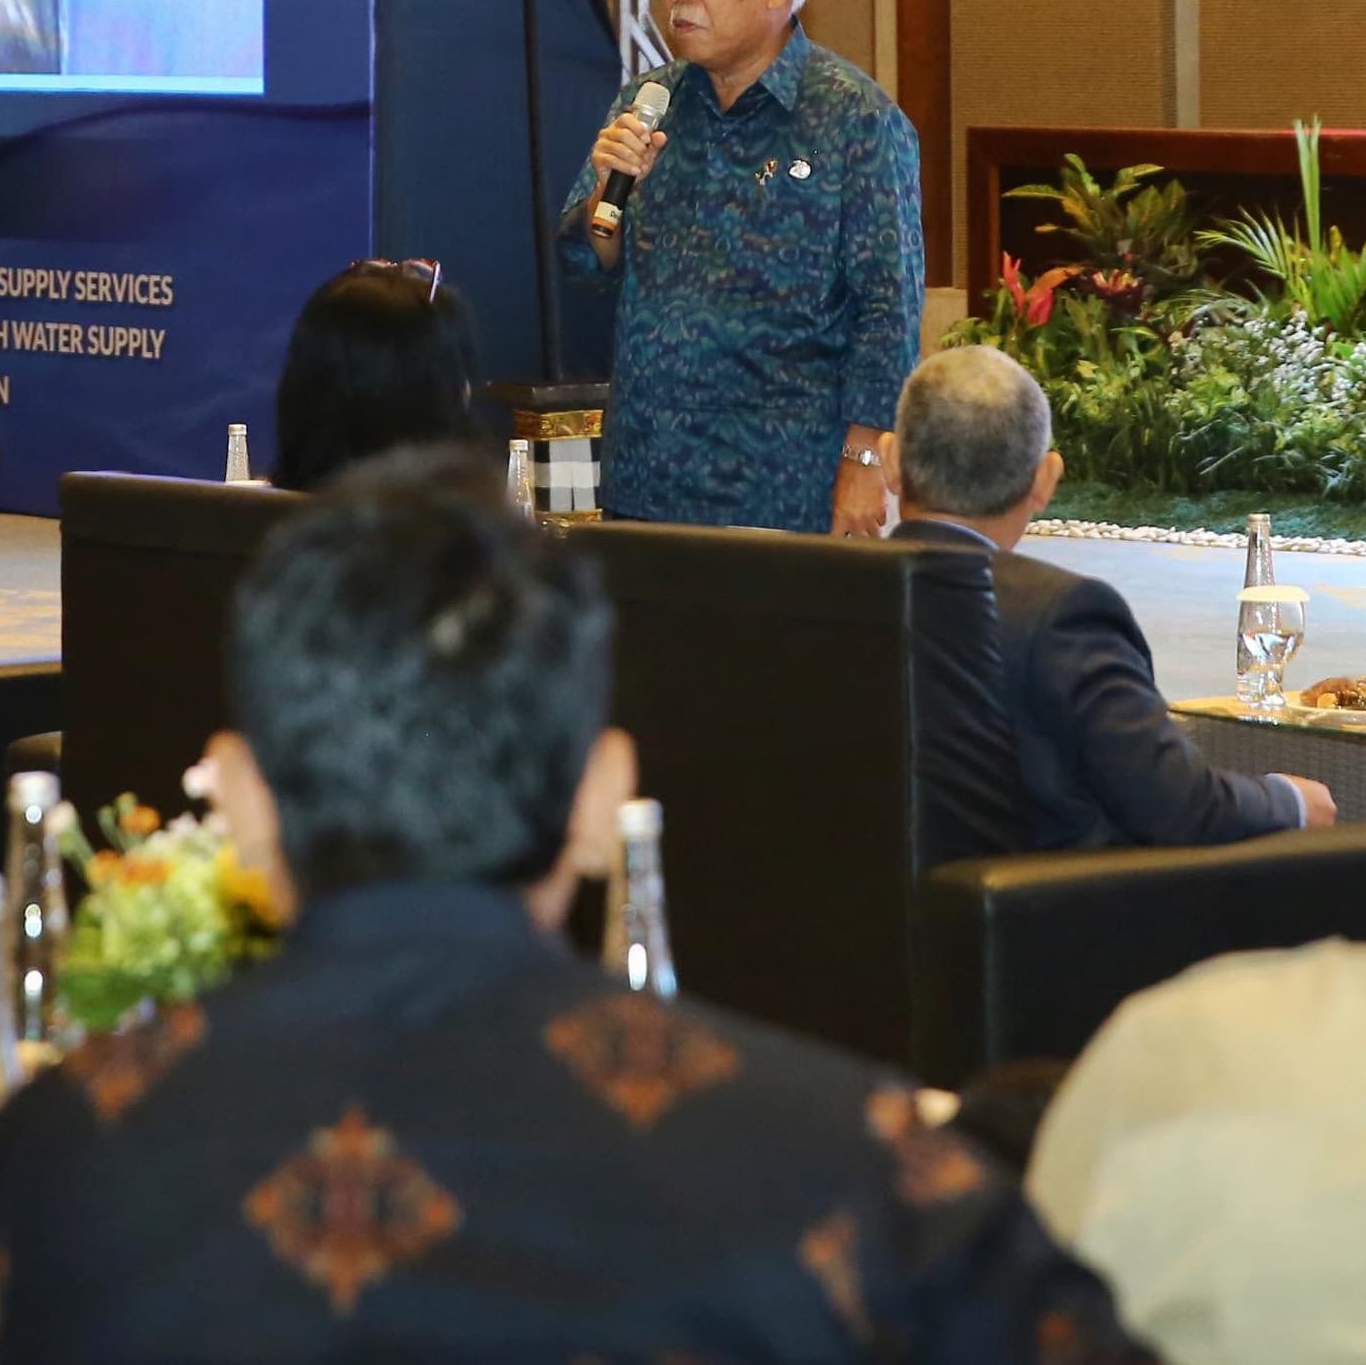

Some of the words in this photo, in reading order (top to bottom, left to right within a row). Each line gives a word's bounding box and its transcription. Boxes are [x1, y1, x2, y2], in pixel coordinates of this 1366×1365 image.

[74, 271, 173, 305] SERVICES
[11, 320, 83, 354] WATER
[87, 325, 166, 359] SUPPLY
